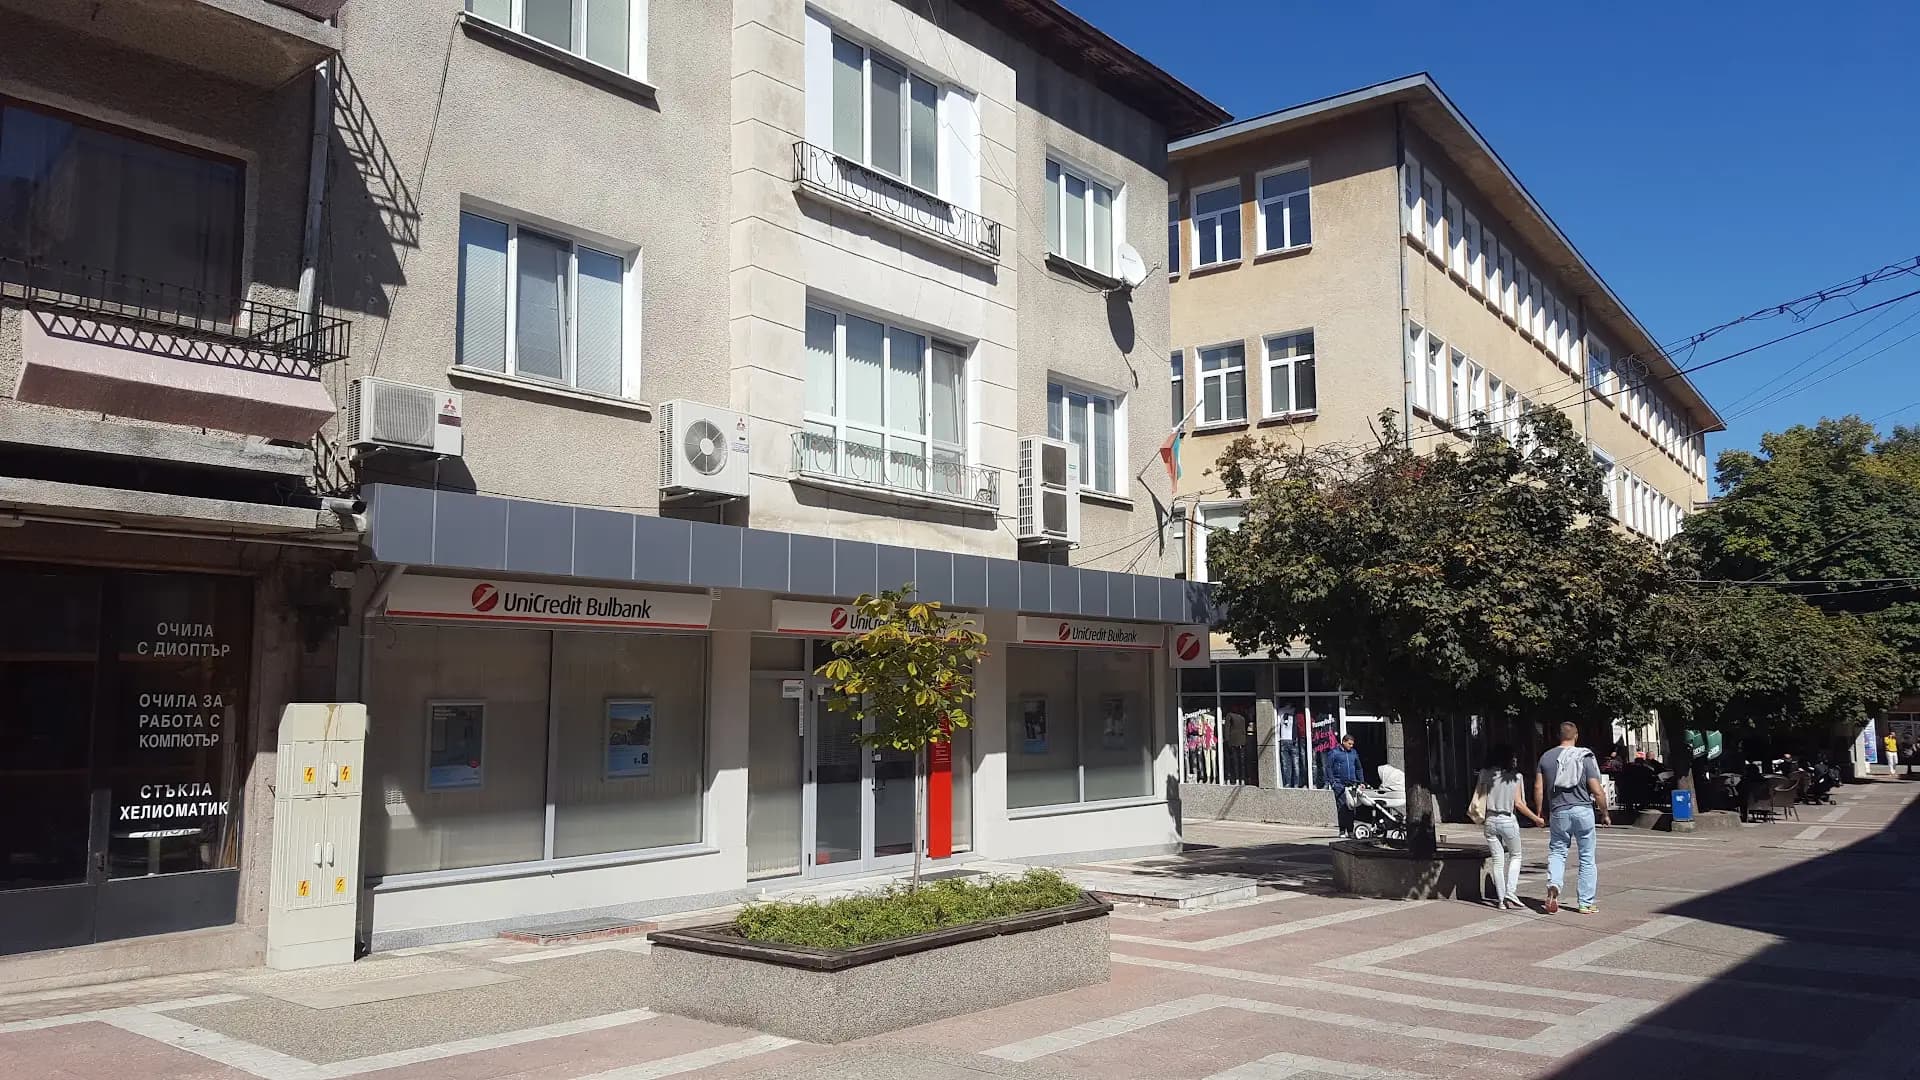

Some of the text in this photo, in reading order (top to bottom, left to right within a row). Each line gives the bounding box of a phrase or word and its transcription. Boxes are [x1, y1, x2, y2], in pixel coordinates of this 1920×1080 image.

[504, 592, 652, 619] UniCredit Bulbank
[156, 622, 214, 637] ОЧИЛА
[1072, 626, 1137, 643] UniCredit Bulbank
[137, 641, 230, 657] С ДИОПТЪР
[139, 693, 223, 708] ОЧИЛА ЗА
[139, 714, 221, 728] РАБОТА С
[139, 734, 220, 748] КОМПЮТЪР
[140, 782, 213, 799] СТЪКЛА
[120, 801, 229, 820] ХЕЛИОМАТИК
